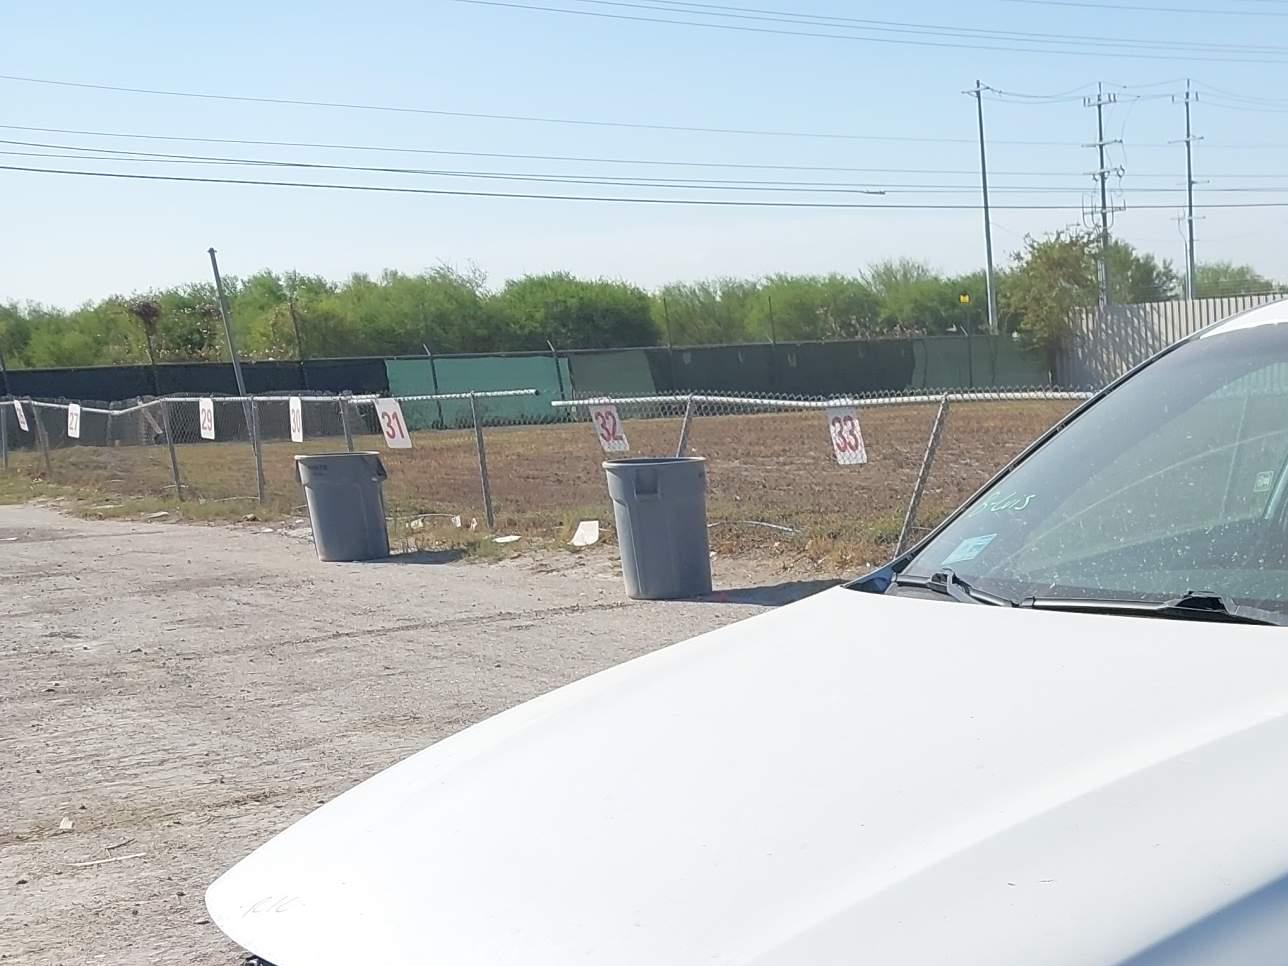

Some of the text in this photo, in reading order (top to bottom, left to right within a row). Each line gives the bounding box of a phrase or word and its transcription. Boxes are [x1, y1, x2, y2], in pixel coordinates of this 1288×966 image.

[201, 408, 213, 431] 29
[291, 409, 301, 433] 30
[381, 411, 404, 439] 31
[594, 411, 623, 442] 32
[831, 415, 859, 453] 33
